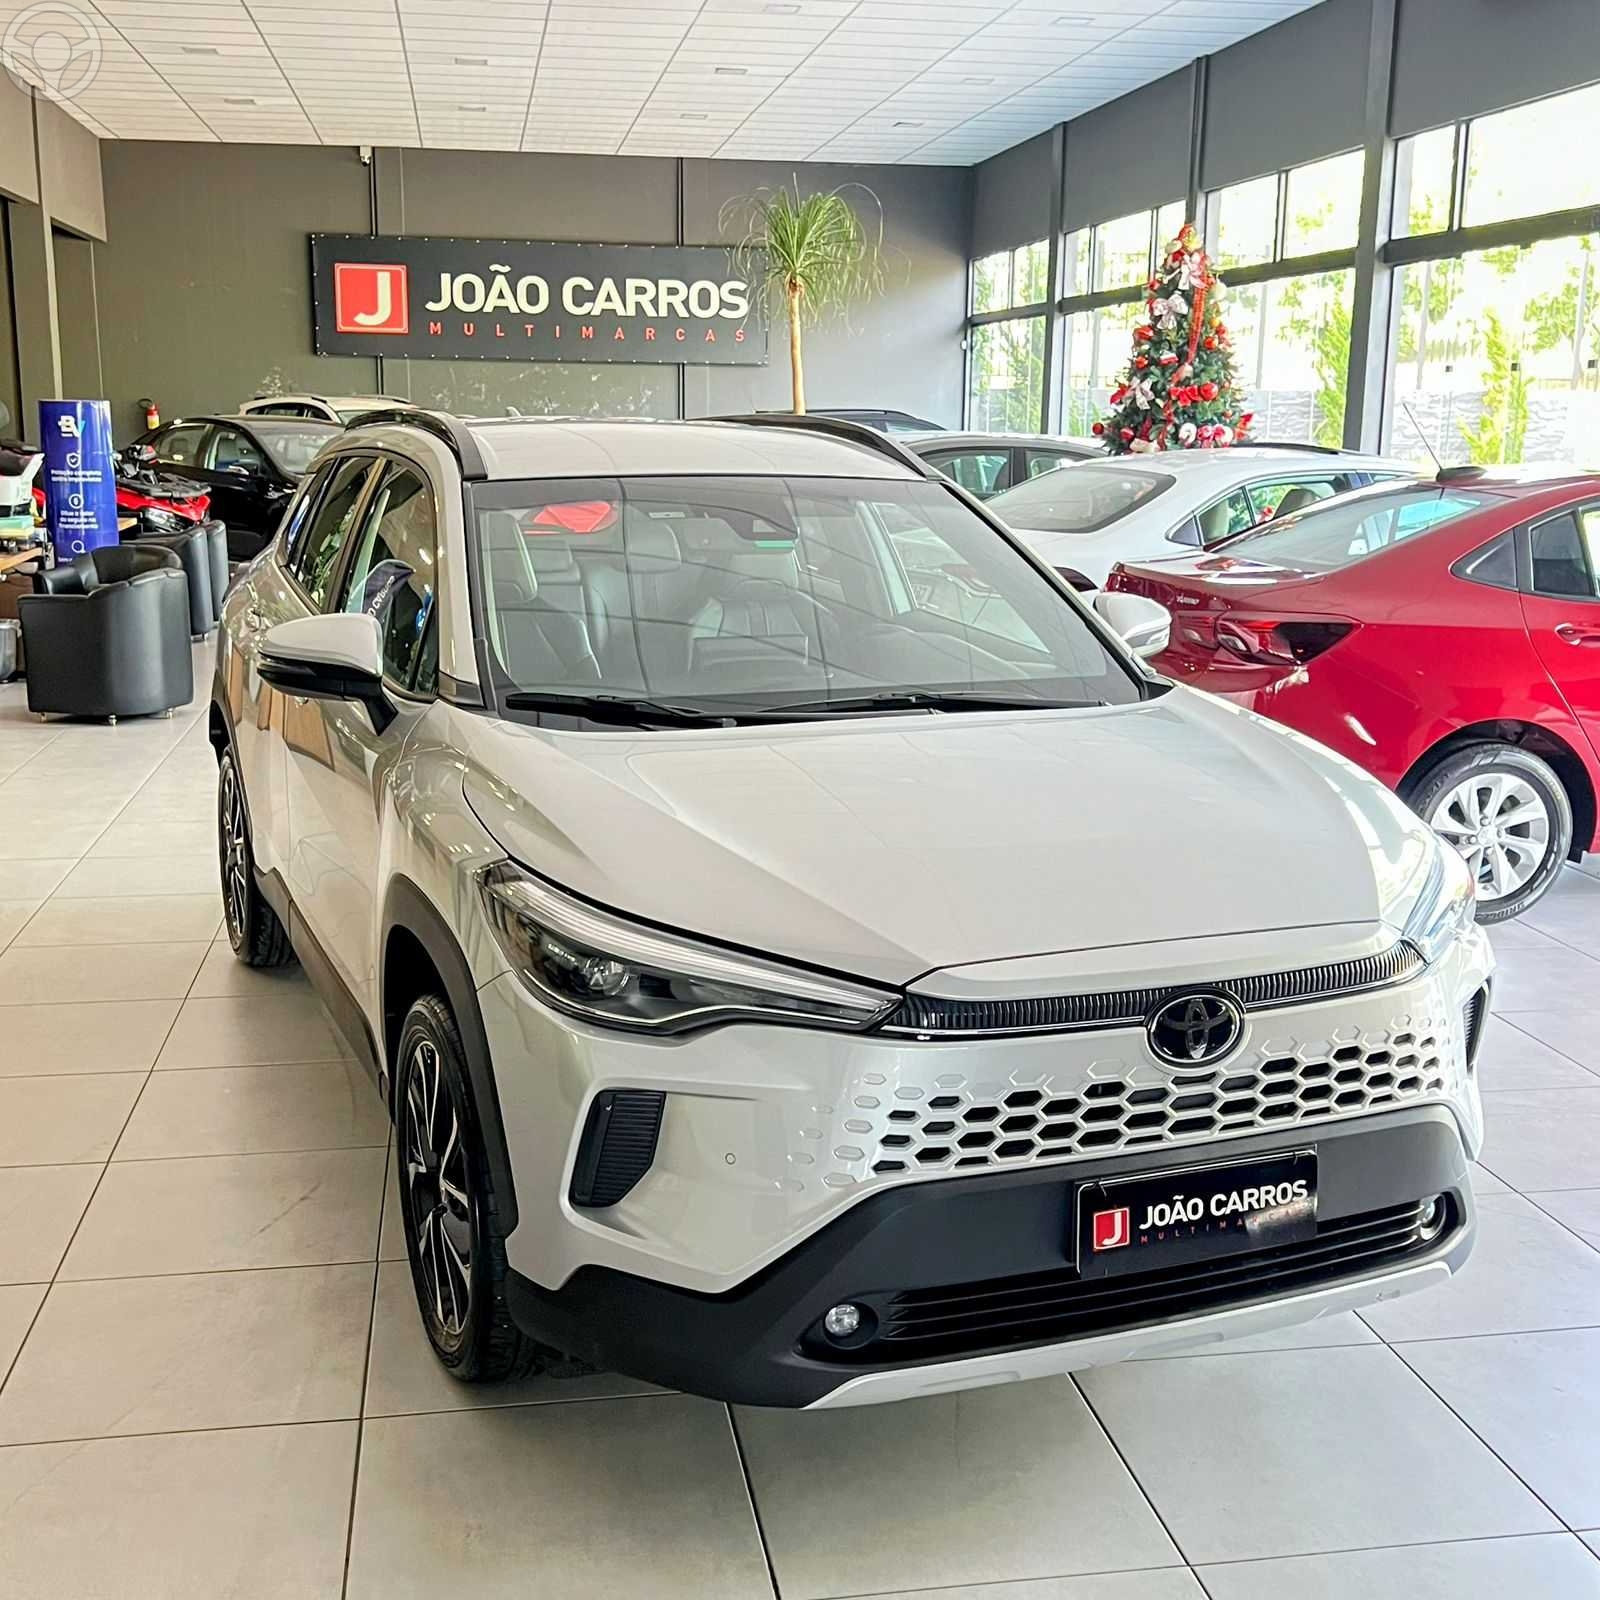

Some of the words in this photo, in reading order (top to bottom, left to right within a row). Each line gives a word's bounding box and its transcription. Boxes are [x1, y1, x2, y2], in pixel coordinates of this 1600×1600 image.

[353, 271, 391, 326] J
[425, 264, 550, 316] JOÃO
[562, 277, 749, 319] CARROS
[429, 322, 745, 343] MULTIMARCAS
[1102, 1212, 1122, 1245] J
[1139, 1194, 1204, 1230] JOÃO
[1210, 1179, 1308, 1217] CARROS
